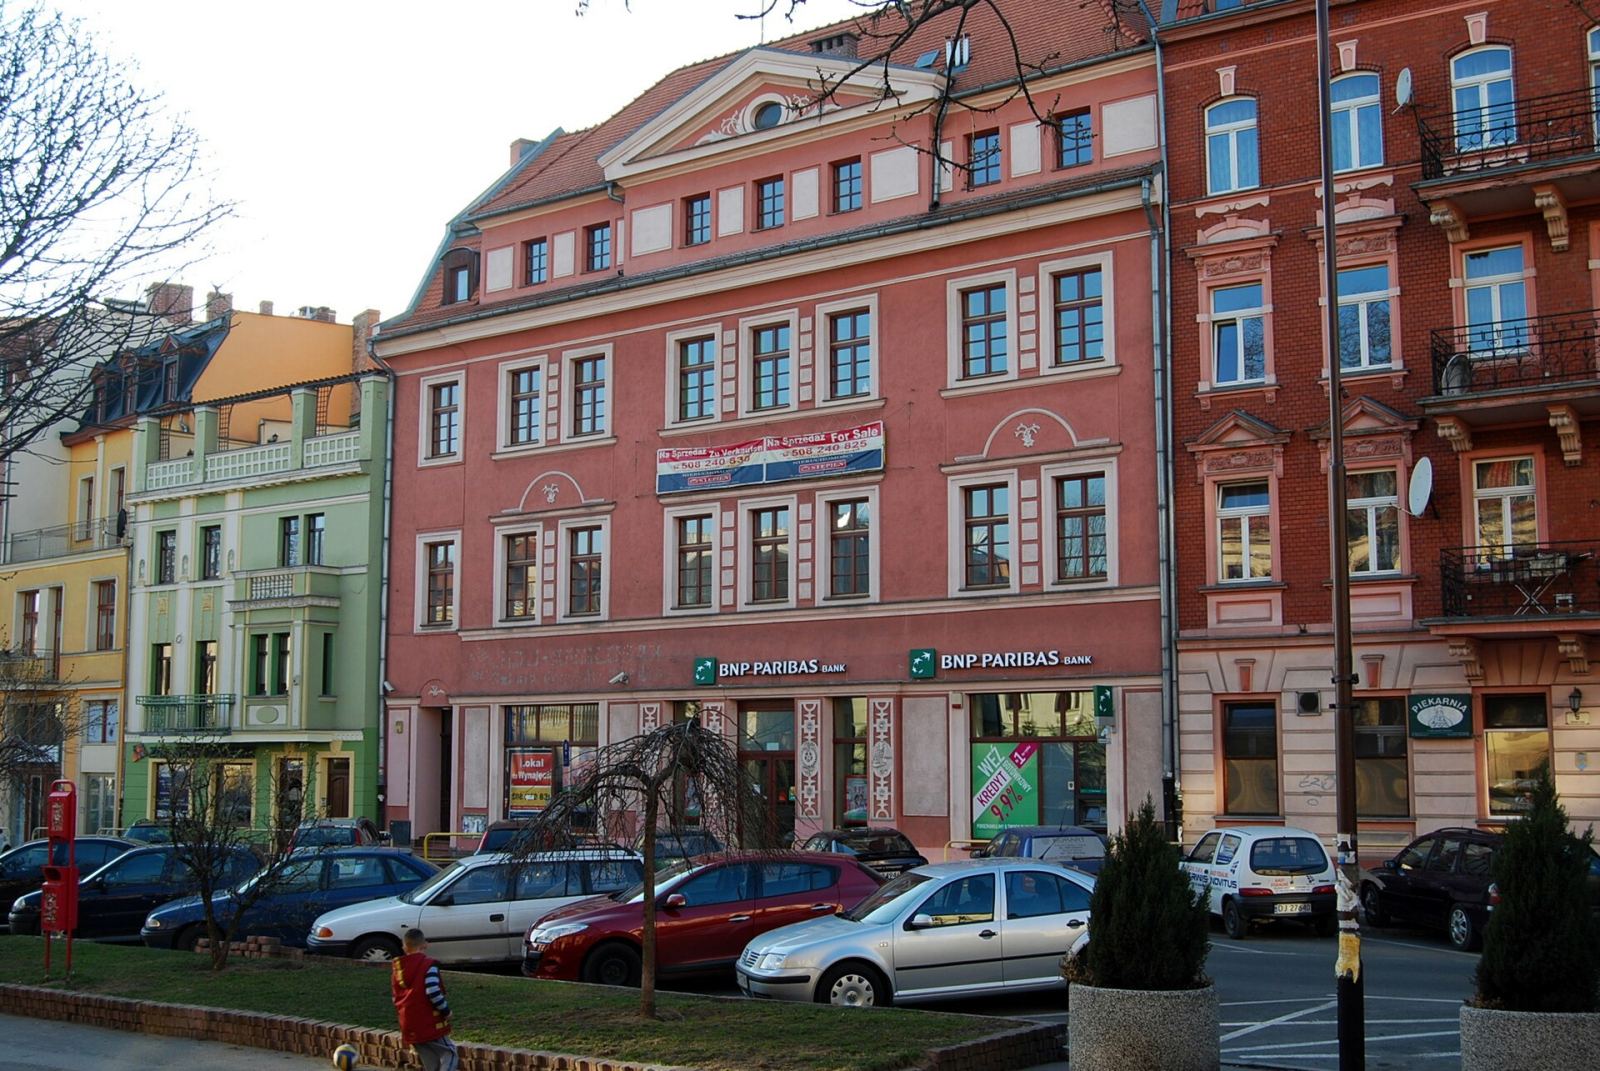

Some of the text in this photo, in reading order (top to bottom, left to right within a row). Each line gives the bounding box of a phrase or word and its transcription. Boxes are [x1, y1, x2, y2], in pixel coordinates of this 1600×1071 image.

[768, 438, 779, 447] Na
[831, 432, 850, 442] For
[853, 427, 878, 439] Sale
[792, 440, 867, 456] 508 240 825
[704, 458, 725, 467] 240
[941, 650, 1092, 669] BNP PARIBAS BANK
[719, 659, 846, 677] BNP PARIBAS BANK
[1411, 697, 1468, 713] PIEKARNIA
[520, 758, 544, 768] Lokal
[976, 771, 1008, 807] KREDYT
[1210, 876, 1237, 889] NOVITUS
